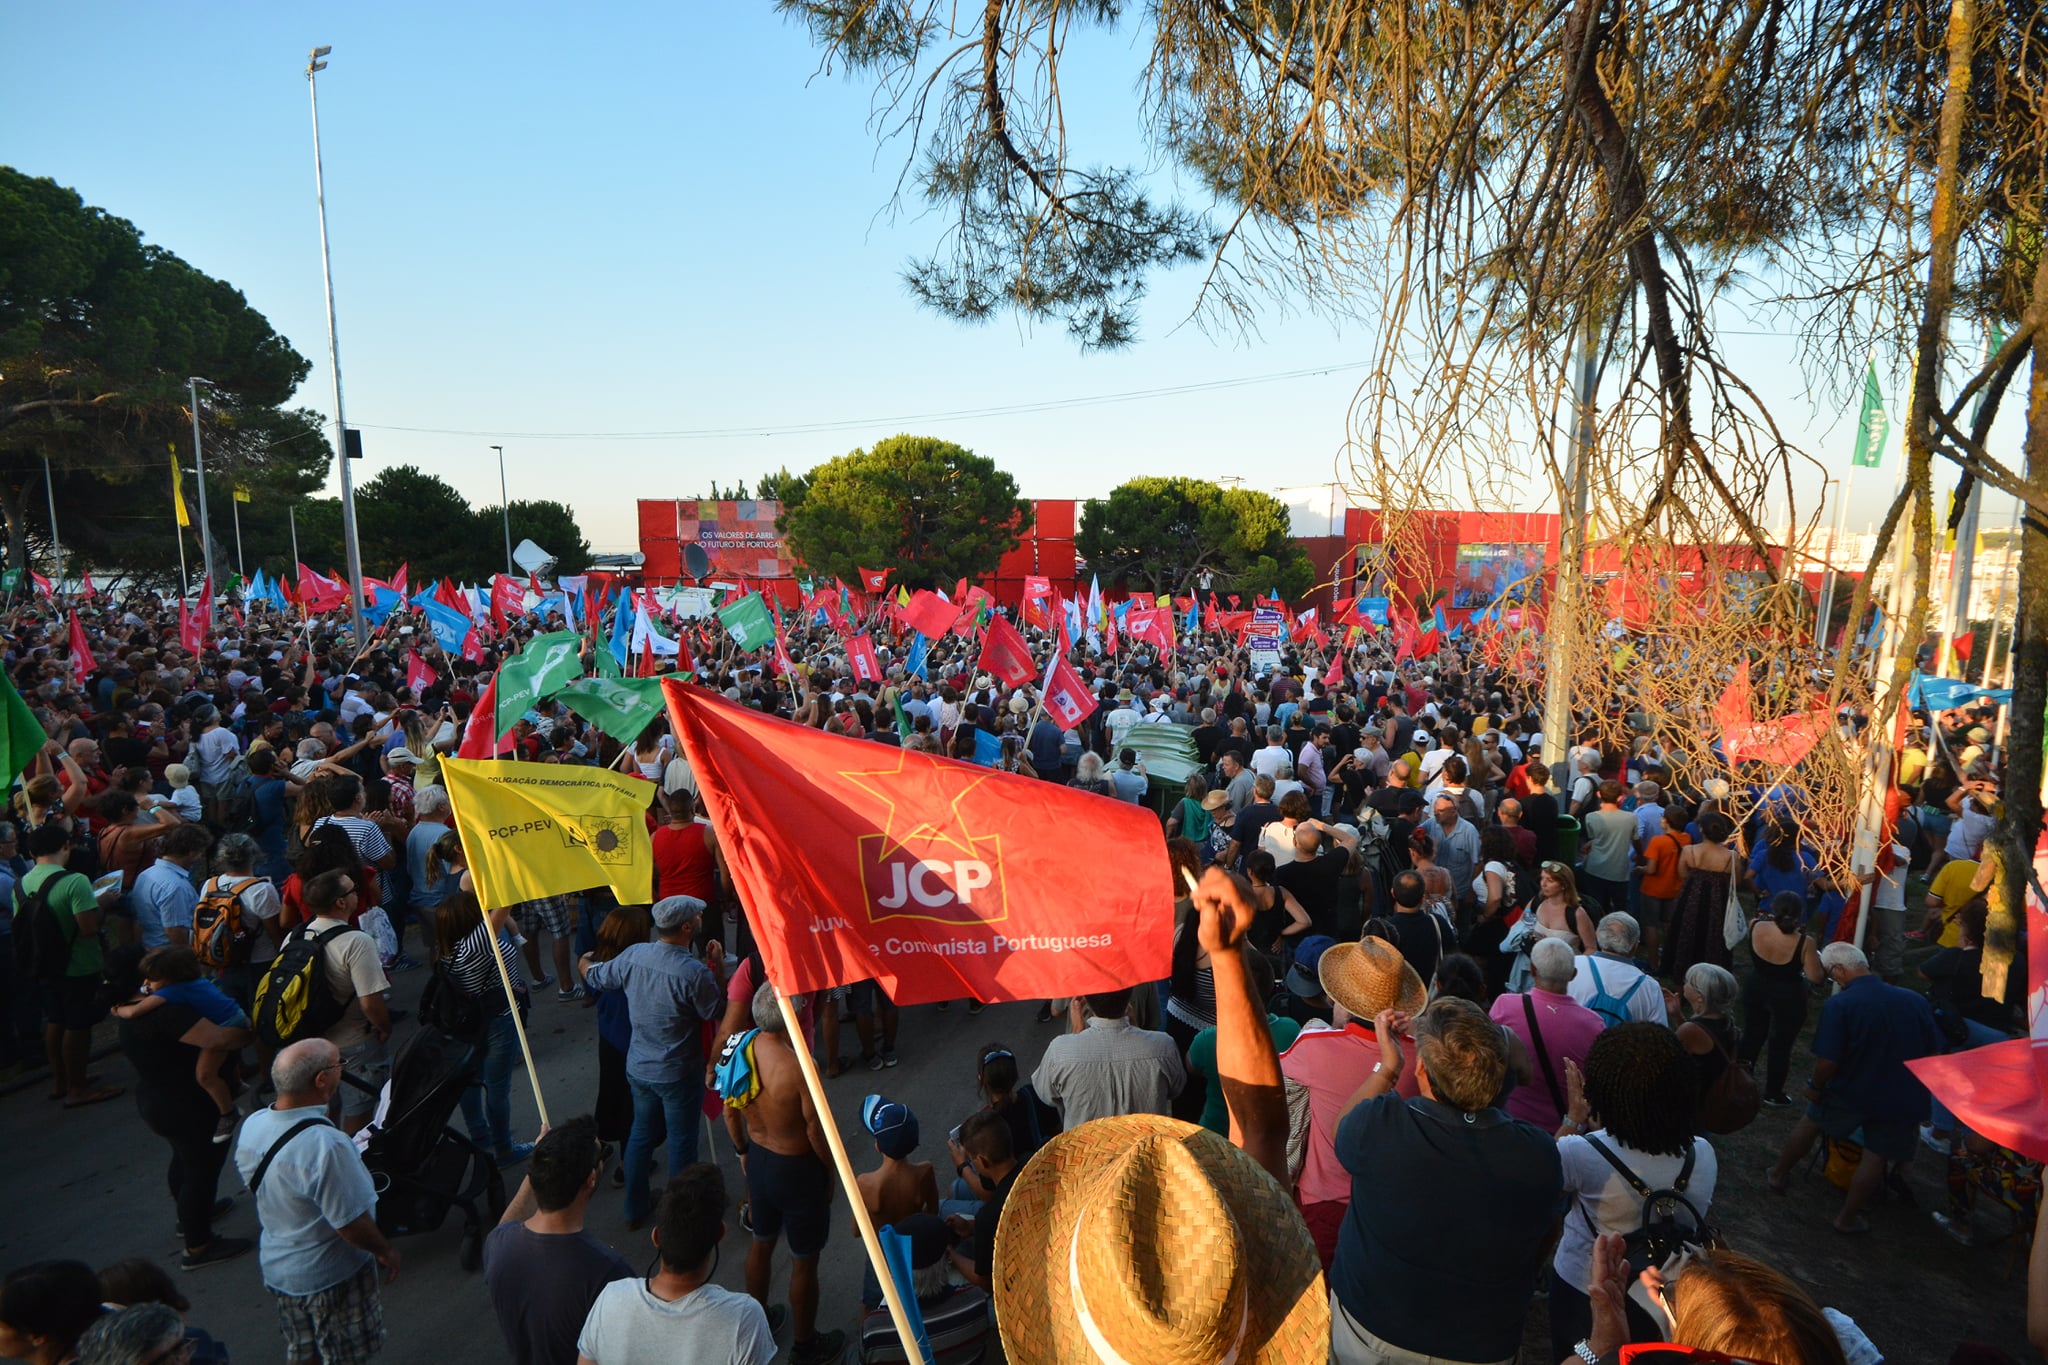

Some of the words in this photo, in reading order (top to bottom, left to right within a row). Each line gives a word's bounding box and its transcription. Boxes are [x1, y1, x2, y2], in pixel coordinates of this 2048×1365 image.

[702, 531, 713, 539] OS
[714, 531, 744, 539] VALORES
[745, 531, 755, 539] DE
[756, 531, 774, 539] ABRIL
[708, 541, 735, 549] FUTURO
[736, 541, 745, 549] DE
[747, 541, 782, 549] PORTUGAL
[499, 688, 530, 708] CP-PEV
[539, 778, 601, 788] DEMOCRÁTICA
[488, 819, 553, 841] PCP-PEV
[877, 858, 993, 909] JCP
[885, 936, 987, 957] Comunista
[992, 932, 1113, 953] Portuguesa
